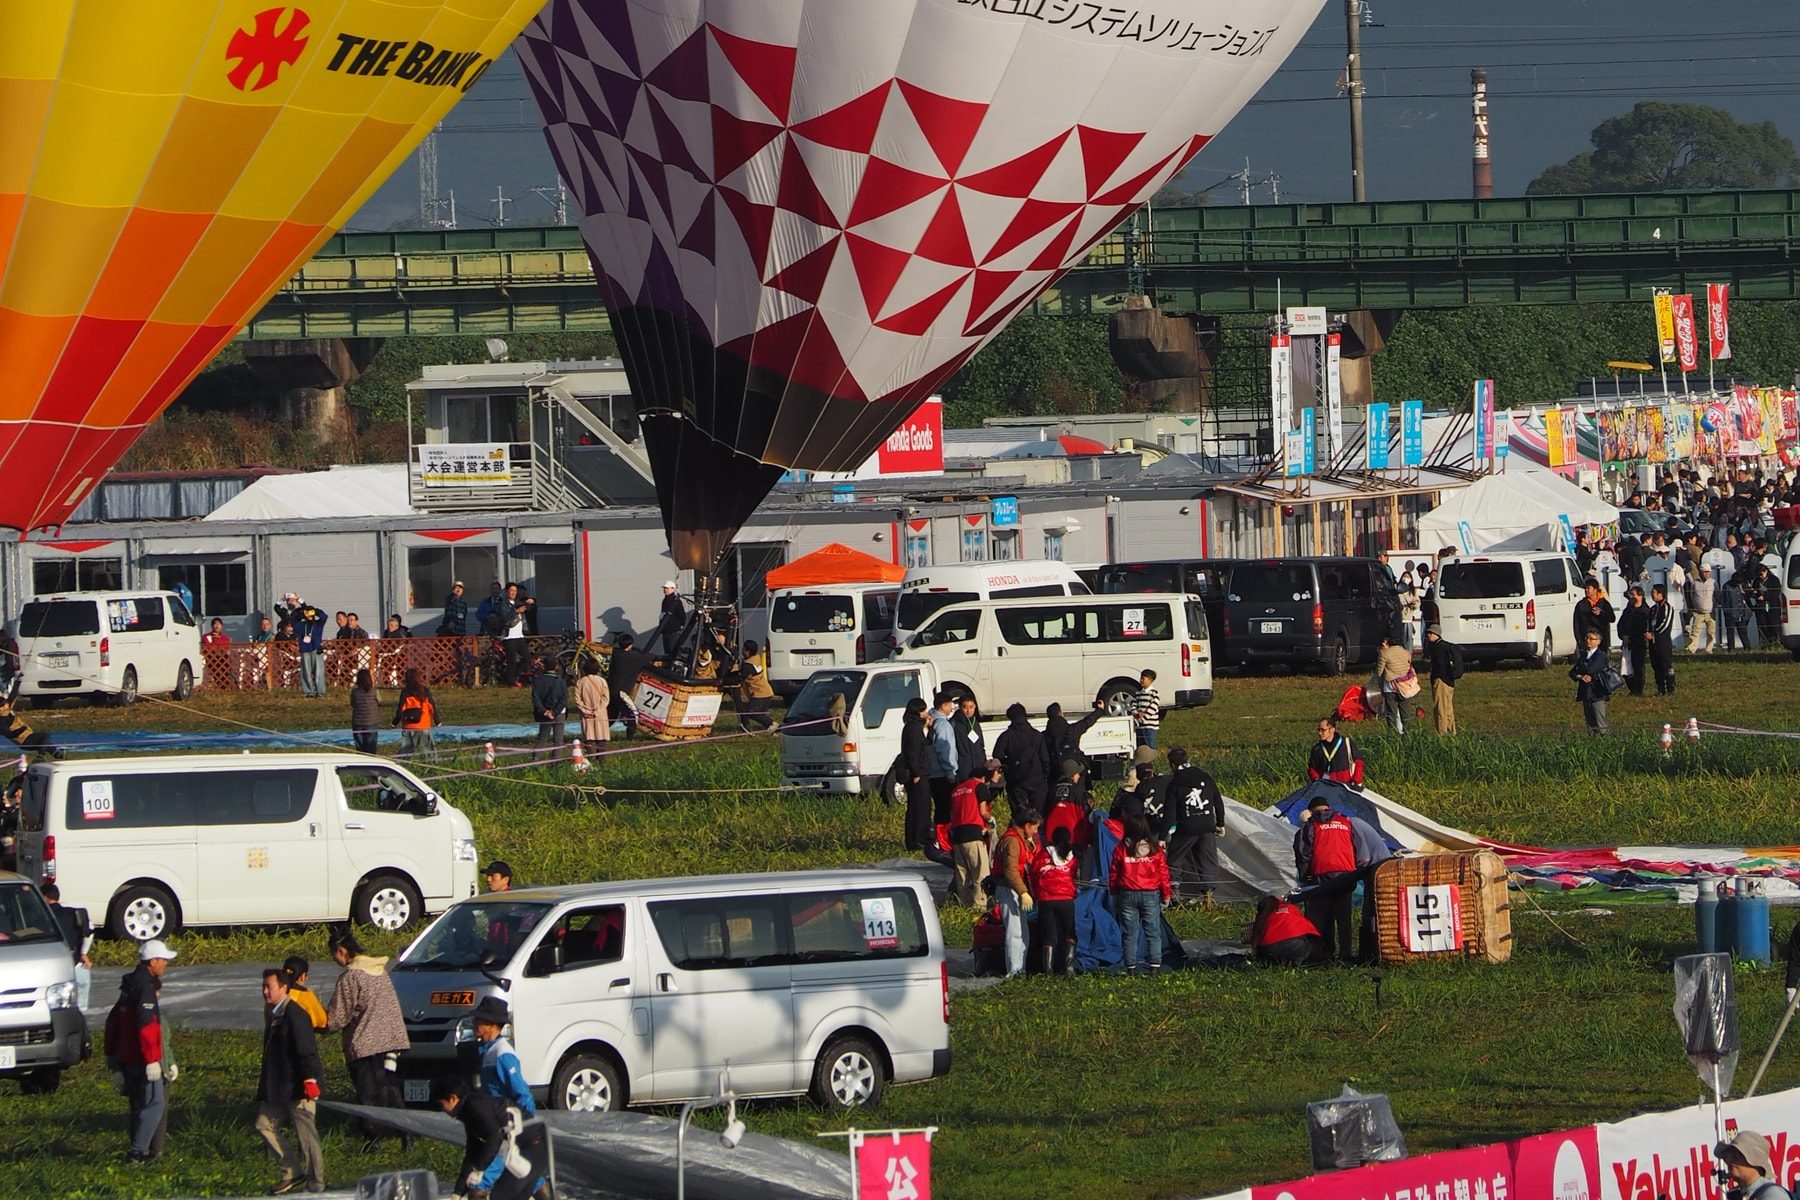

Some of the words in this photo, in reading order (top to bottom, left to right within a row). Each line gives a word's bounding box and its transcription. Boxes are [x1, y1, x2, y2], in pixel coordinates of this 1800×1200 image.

[326, 33, 409, 76] THE
[394, 41, 482, 88] BANK
[886, 429, 910, 453] Honda
[910, 422, 933, 452] Goods
[427, 461, 506, 474] 大会運営本部
[987, 574, 1021, 587] HONDA
[1127, 620, 1142, 630] 27
[643, 690, 664, 711] 27
[86, 798, 110, 811] 100
[868, 920, 894, 937] 113
[1415, 894, 1442, 941] 115
[1453, 902, 1461, 931] HONDA
[884, 1155, 919, 1200] 公
[1612, 1144, 1721, 1200] Yakult
